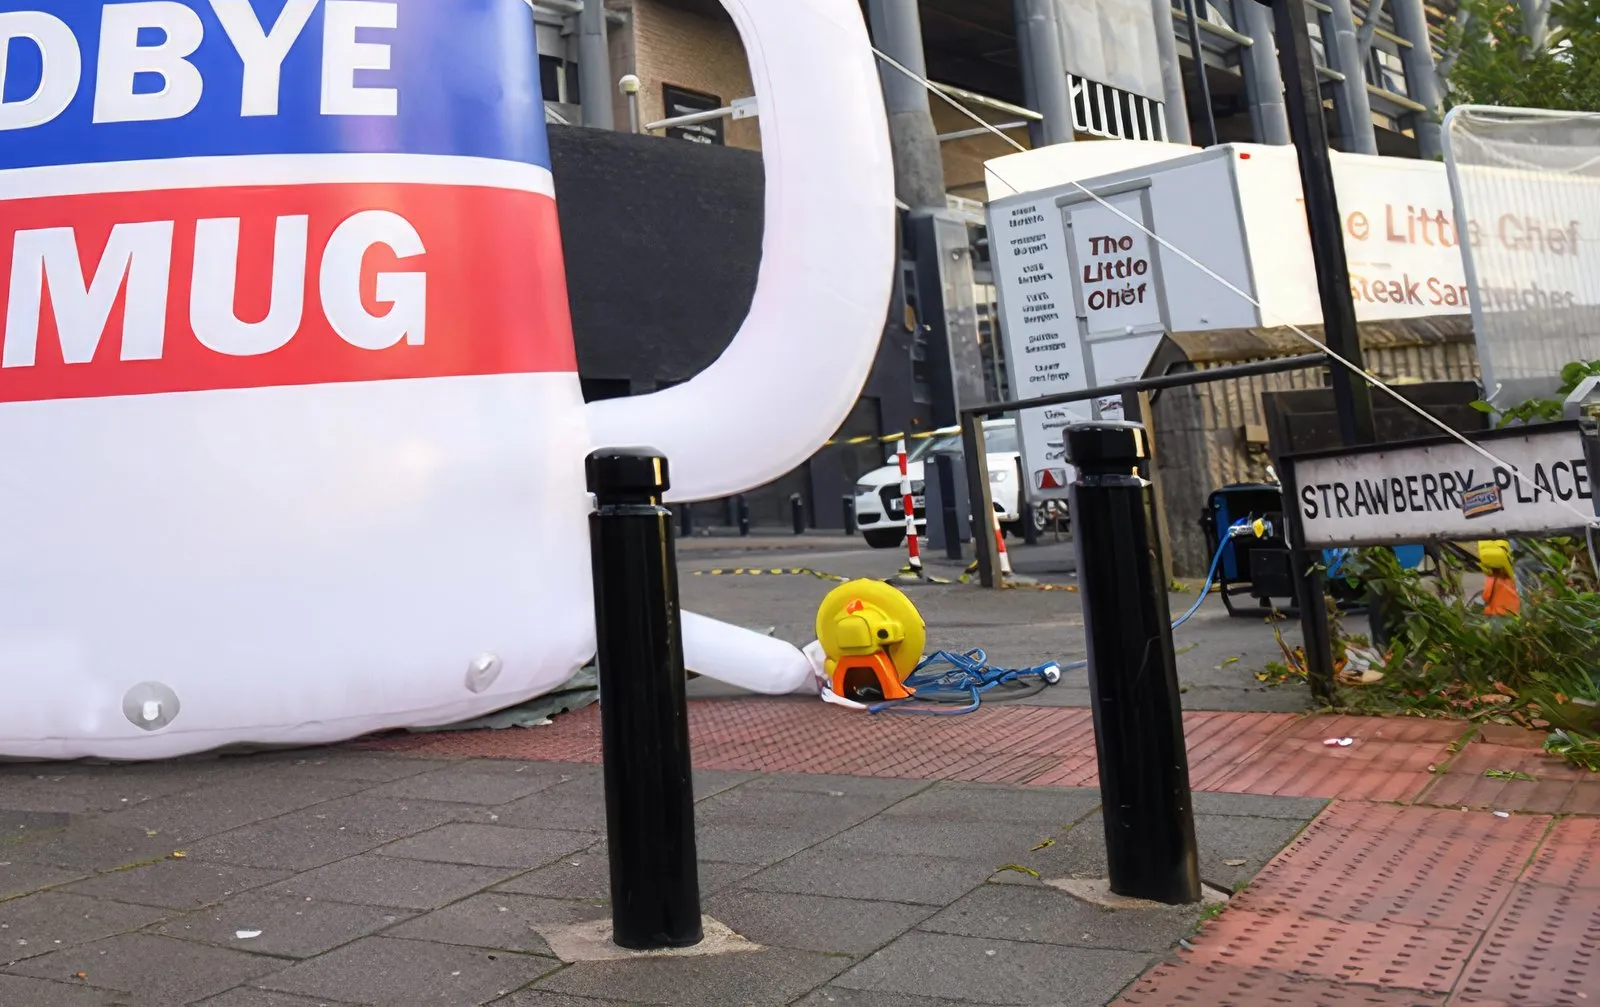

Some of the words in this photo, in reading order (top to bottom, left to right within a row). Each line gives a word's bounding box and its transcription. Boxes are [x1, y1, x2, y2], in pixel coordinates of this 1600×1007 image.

[1, 209, 427, 370] MUG
[1301, 468, 1474, 520] STRAWBERRY
[1492, 459, 1593, 504] PLACE
